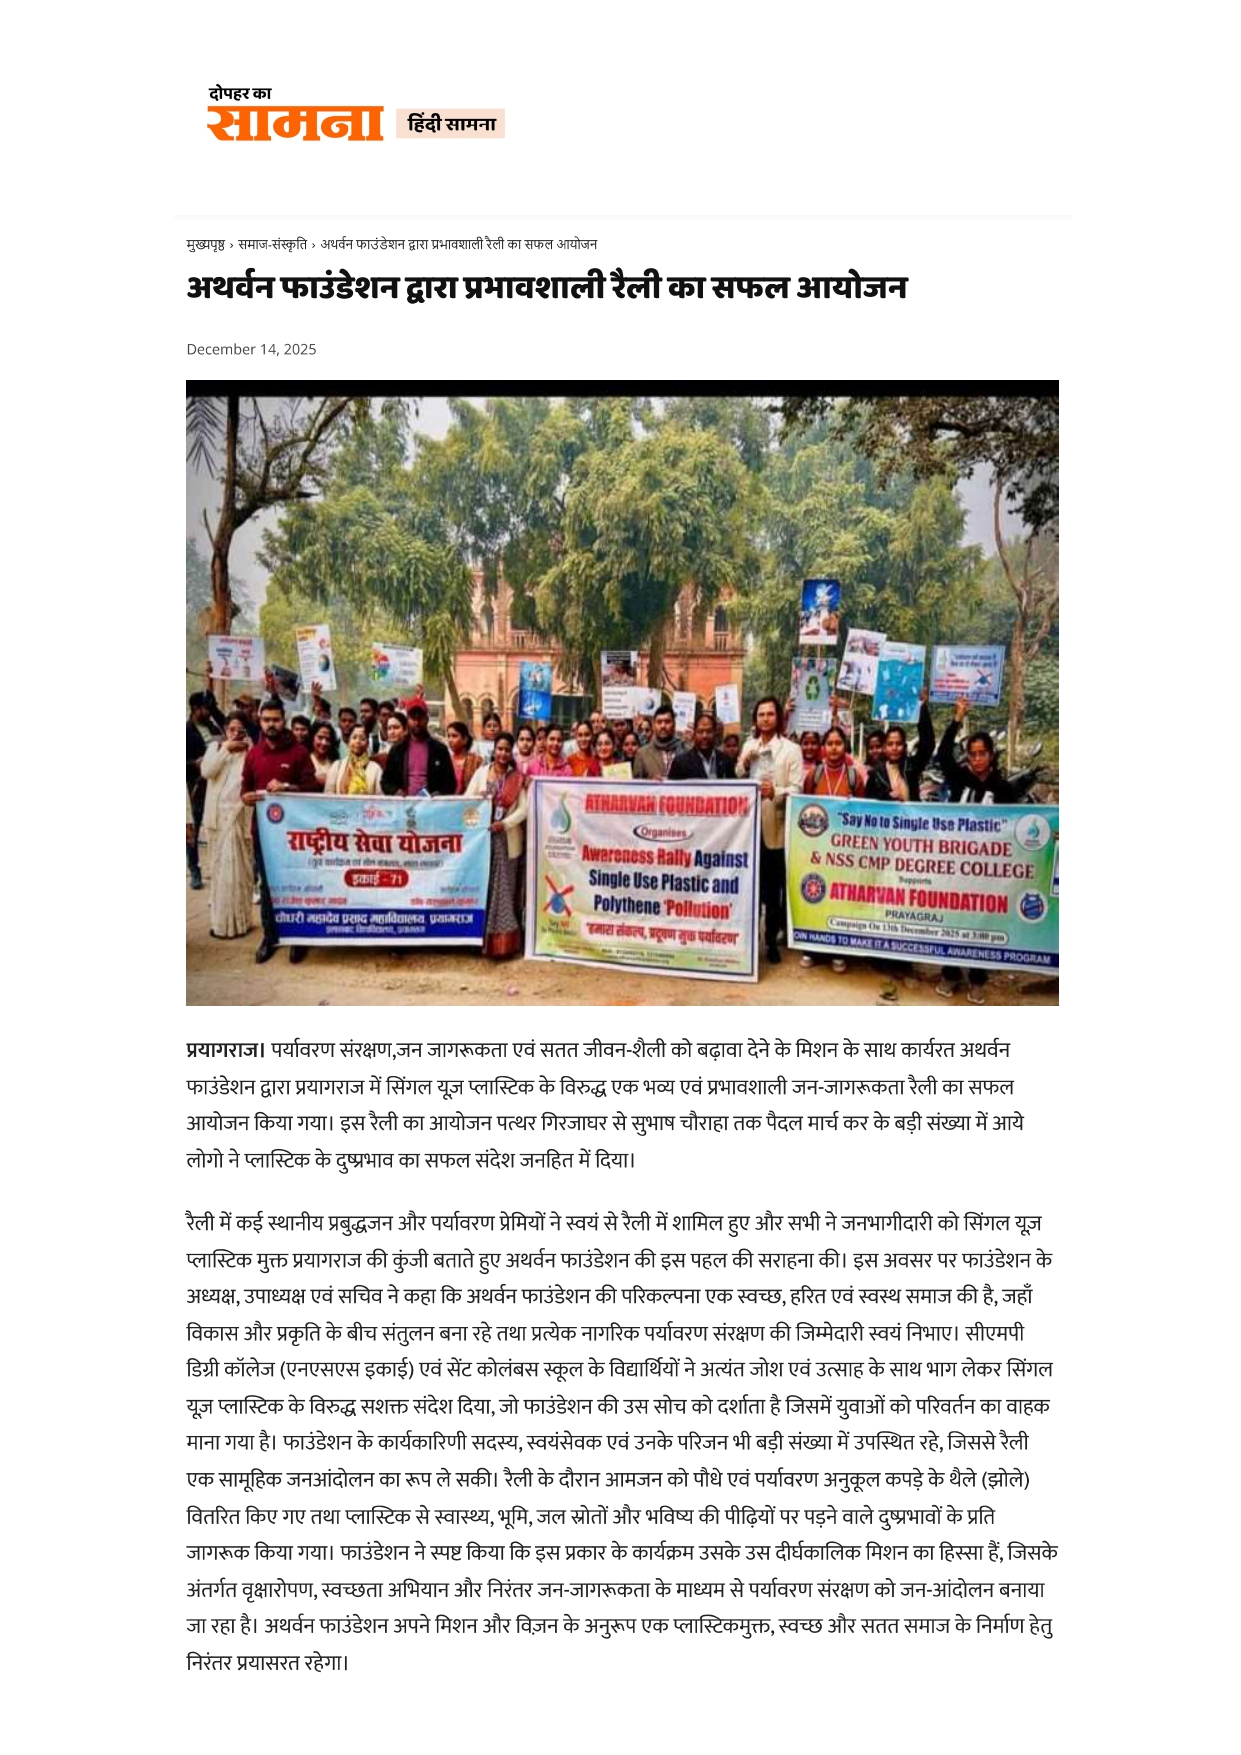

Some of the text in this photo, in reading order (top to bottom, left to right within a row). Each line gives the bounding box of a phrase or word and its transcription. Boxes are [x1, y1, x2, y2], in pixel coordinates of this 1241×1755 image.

[209, 84, 272, 101] दोपहर का
[207, 106, 384, 141] सामना
[407, 112, 497, 133] हिंदी सामना
[186, 236, 597, 252] मुख्यपृष्ठ समाज-संस्कृति अथर्वन फाउंडेशन द्वारा प्रभावशाली रैली का सफल आयोजन
[187, 267, 909, 304] अथर्वन फाउंडेशन द्वारा प्रभावशाली रैली का सफल आयोजन
[188, 343, 316, 356] December 14, 2025
[586, 794, 749, 816] ATHARVAN FOUNDATION
[641, 826, 686, 838] Organises
[864, 814, 877, 826] No
[880, 814, 890, 827] to
[893, 816, 929, 832] Single
[932, 818, 954, 832] Use
[287, 828, 463, 855] राष्ट्रीय सेवा योजना
[831, 834, 878, 851] GREEN
[884, 836, 934, 854] YOUTH
[939, 840, 1012, 857] BRIGADE
[582, 845, 653, 864] Awareness
[658, 846, 691, 867] Rally
[694, 850, 748, 869] Against
[810, 851, 1034, 880] & NSS CMP DEGREE COLLEGE
[391, 874, 402, 884] 71
[589, 870, 738, 894] Single Use Plastic and
[594, 895, 661, 915] Polythene
[830, 882, 1008, 914] ATHARVAN FOUNDATION
[885, 910, 944, 923] PRAYAGRAJ
[830, 919, 866, 930] Campaign
[869, 922, 880, 930] On
[900, 925, 938, 936] December
[962, 931, 970, 939] at
[793, 931, 1051, 964] OIN HANDS TO MAKE IT A SUCCESSFUL AWARENESS PROGRAM
[186, 1037, 1011, 1061] प्रयागराज। पर्यावरण संरक्षण,जन जागरूकता एवं सतत जीवन-शैली को बढ़ावा देने के मिशन के साथ कार्यरत अथर्वन
[186, 1074, 1014, 1100] फाउंडेशन द्वारा प्रयागराज में सिंगल यूज़ प्लास्टिक के विरुद्ध एक भव्य एवं प्रभावशाली जन-जागरूकता रैली का सफल
[186, 1148, 633, 1174] लोगो ने प्लास्टिक के दुष्प्रभाव का सफल संदेश जनहित में दिया।
[187, 1577, 1045, 1603] अंतर्गत वृक्षारोपण, स्वच्छता अभियान और निरंतर जन-जागरूकता के माध्यम से पर्यावरण संरक्षण को जन-आंदोलन बनाया
[186, 1651, 347, 1672] निरंतर प्रयासरत रहेगा।
